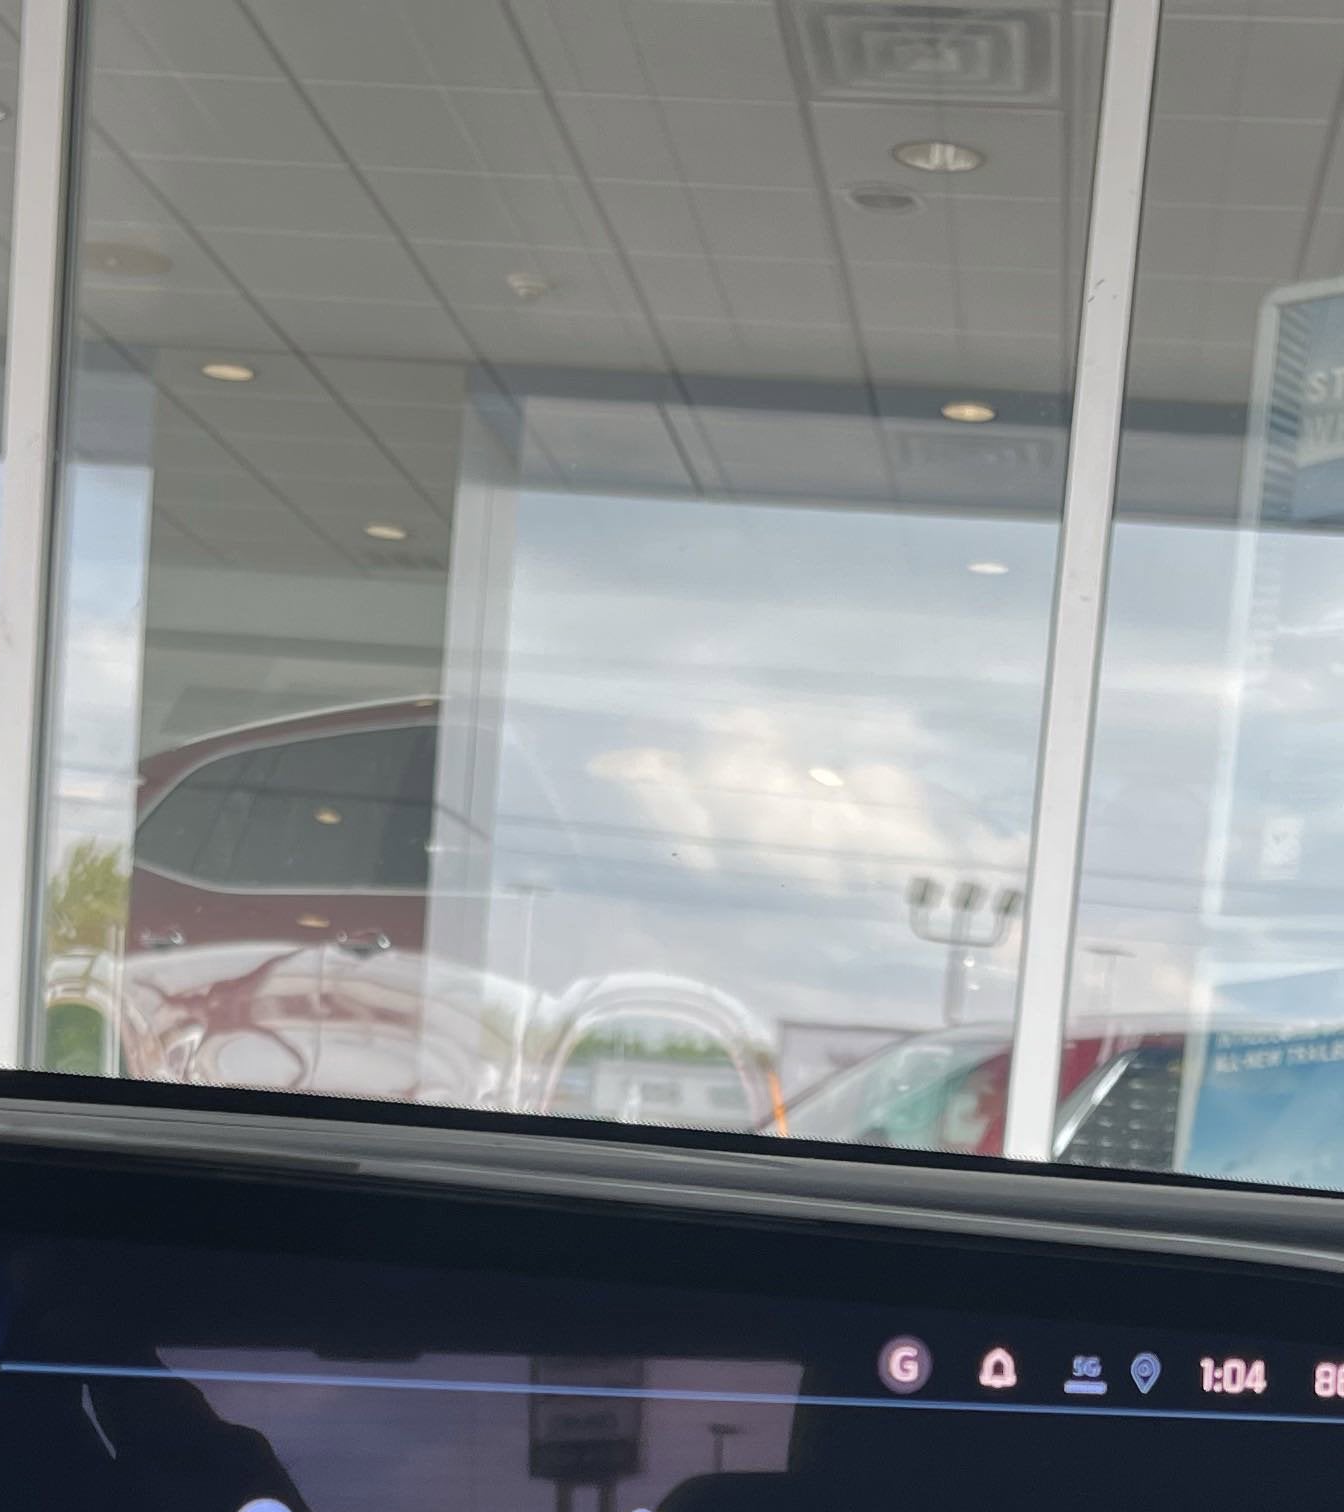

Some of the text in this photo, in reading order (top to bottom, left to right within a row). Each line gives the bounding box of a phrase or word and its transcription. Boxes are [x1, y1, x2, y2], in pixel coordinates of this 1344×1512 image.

[889, 1346, 919, 1382] G
[1072, 1356, 1102, 1377] 5G
[1200, 1357, 1267, 1394] 1:04
